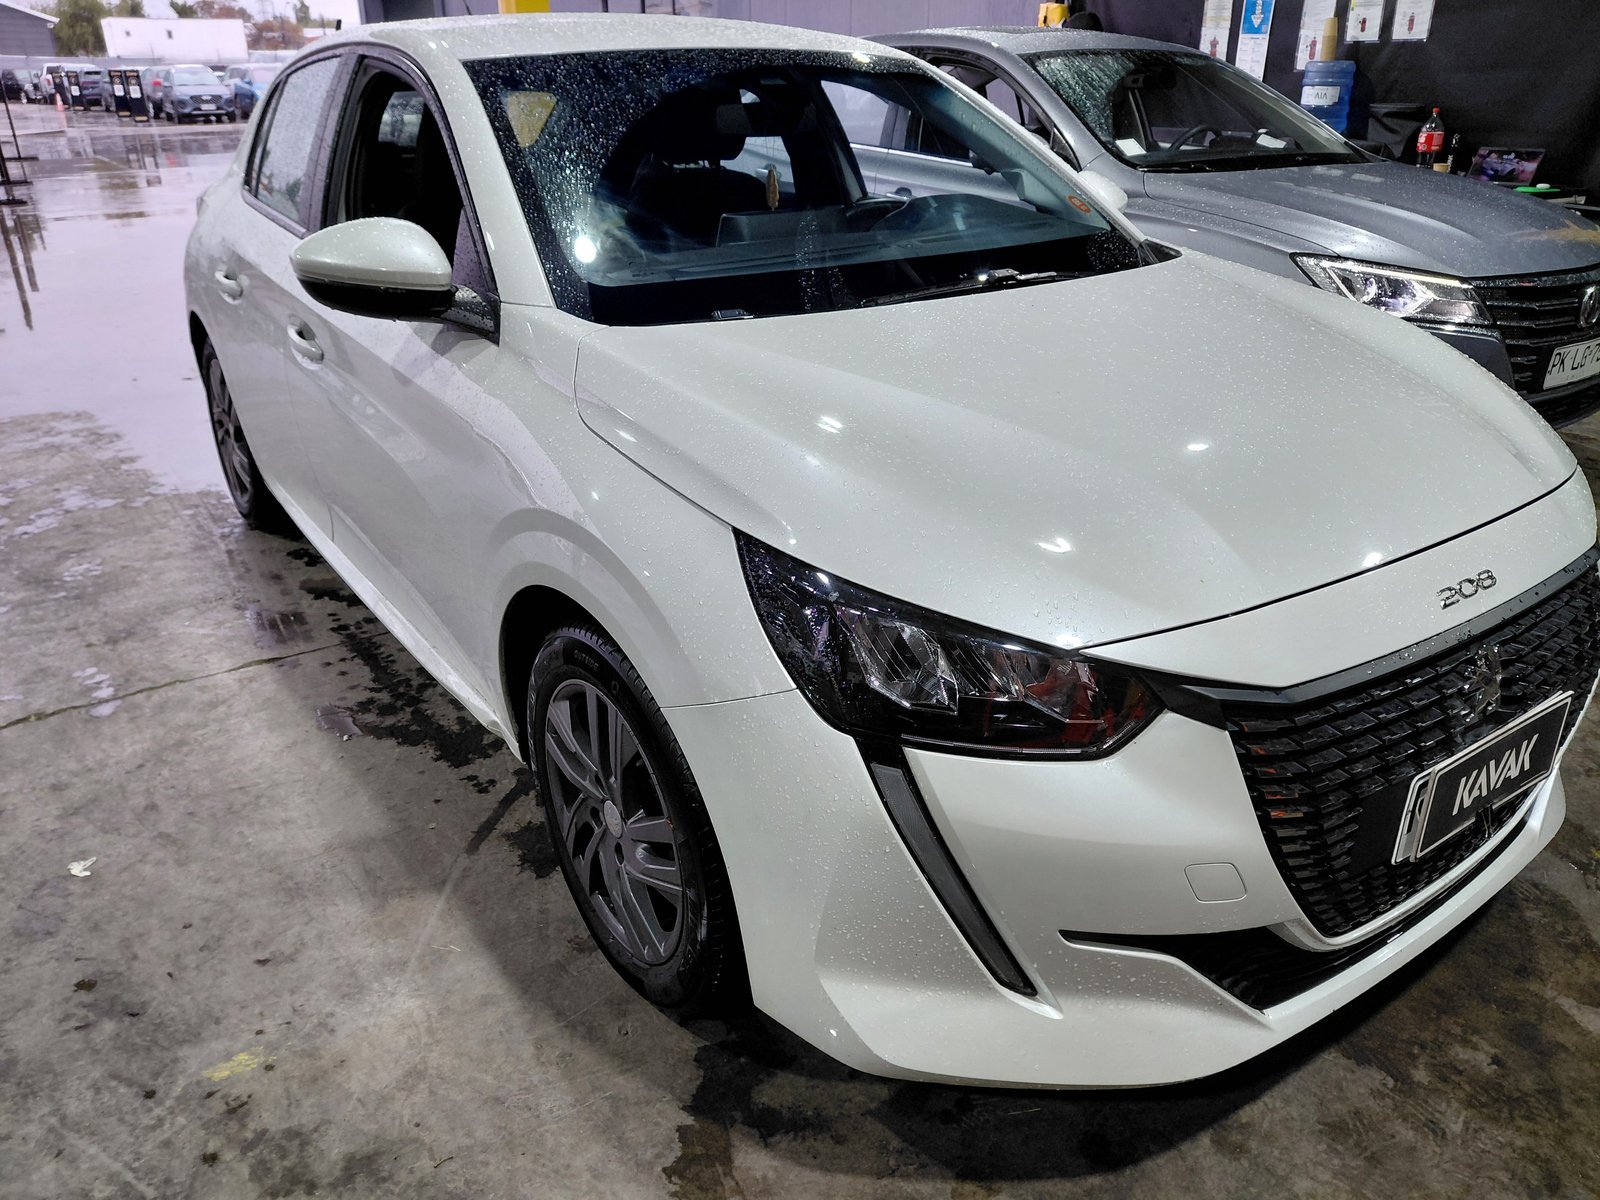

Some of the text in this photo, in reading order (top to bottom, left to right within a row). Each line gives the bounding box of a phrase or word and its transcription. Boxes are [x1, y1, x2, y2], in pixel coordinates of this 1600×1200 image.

[1549, 350, 1571, 376] PK
[1437, 569, 1497, 609] 208
[1452, 733, 1539, 816] KAVAK
